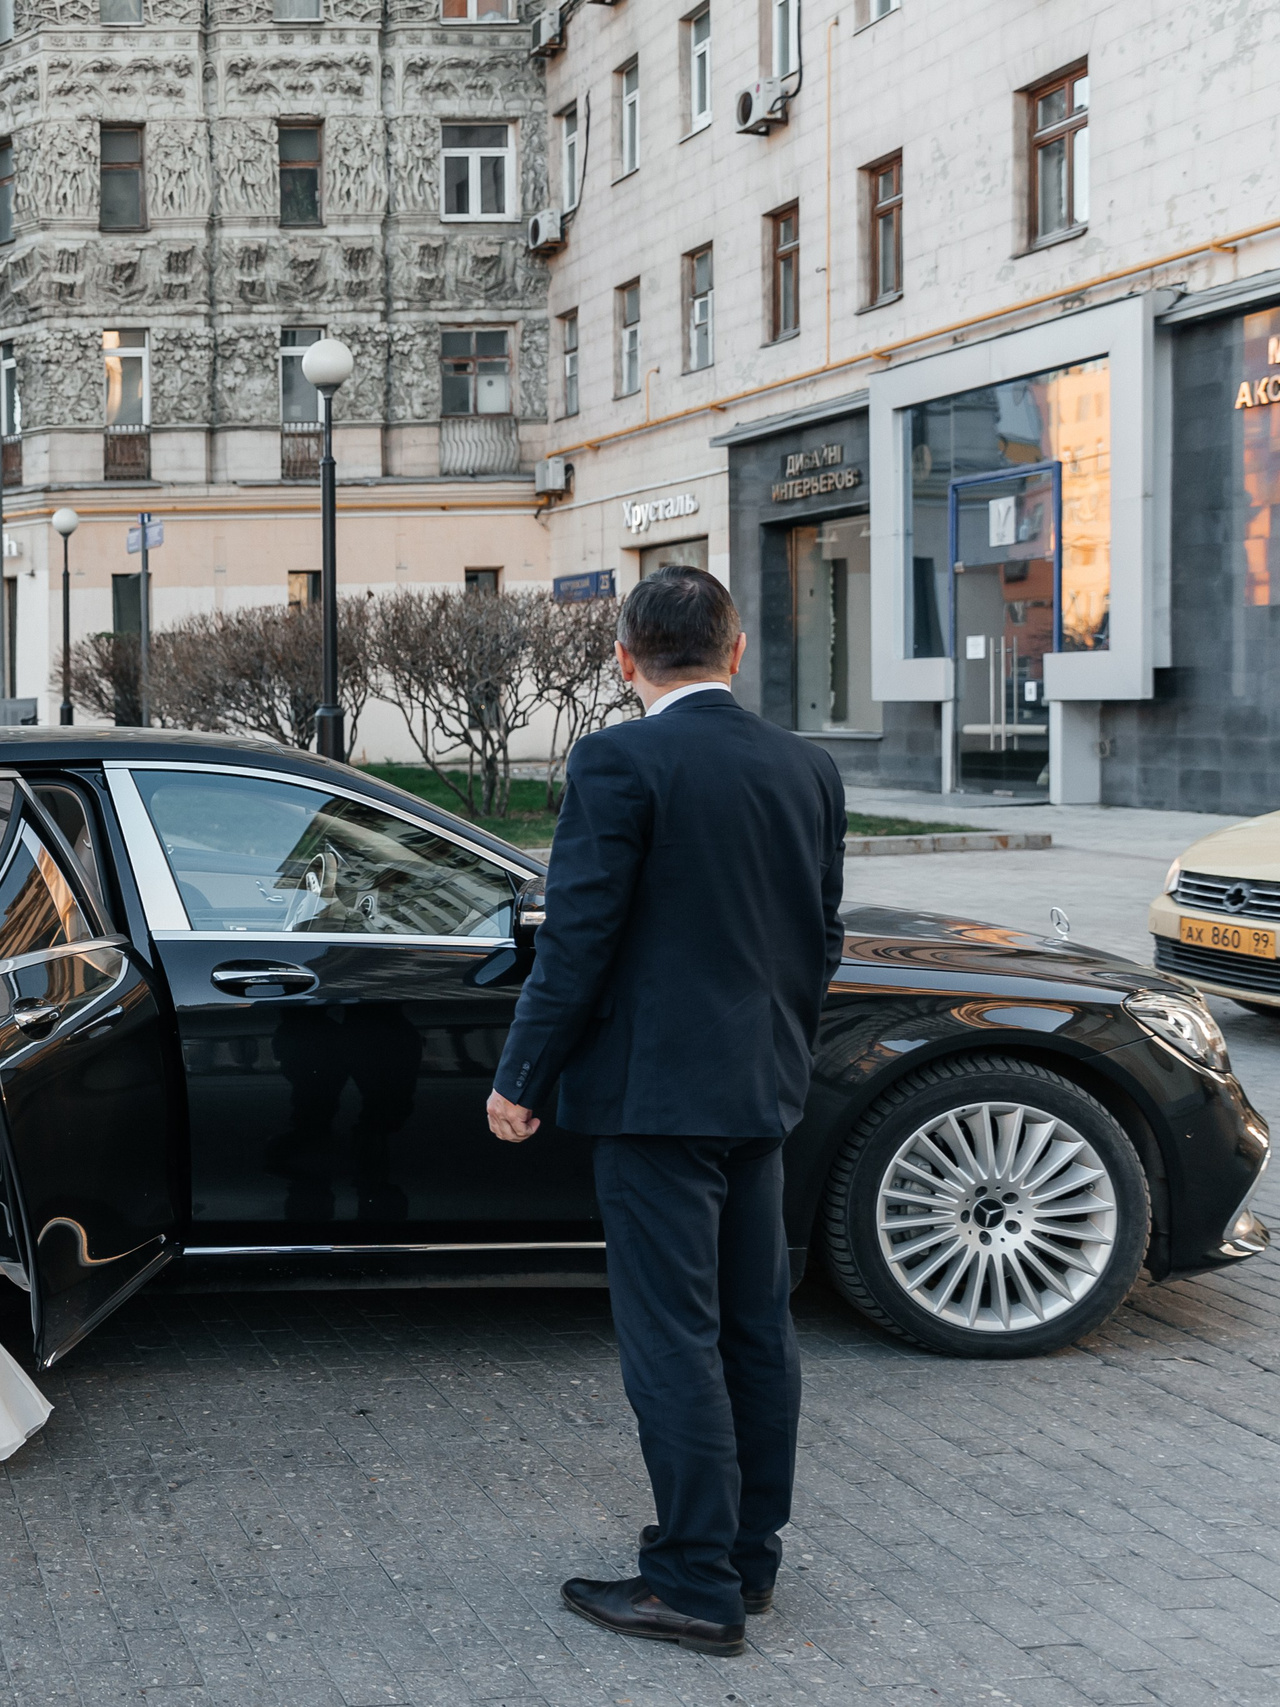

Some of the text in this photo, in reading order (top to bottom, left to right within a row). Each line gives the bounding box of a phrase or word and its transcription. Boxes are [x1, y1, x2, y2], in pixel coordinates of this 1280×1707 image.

[771, 467, 858, 502] ИНТЕРЬЕРОВ
[622, 494, 699, 534] Хрусталь
[1211, 926, 1241, 949] 860
[1252, 931, 1269, 949] 99
